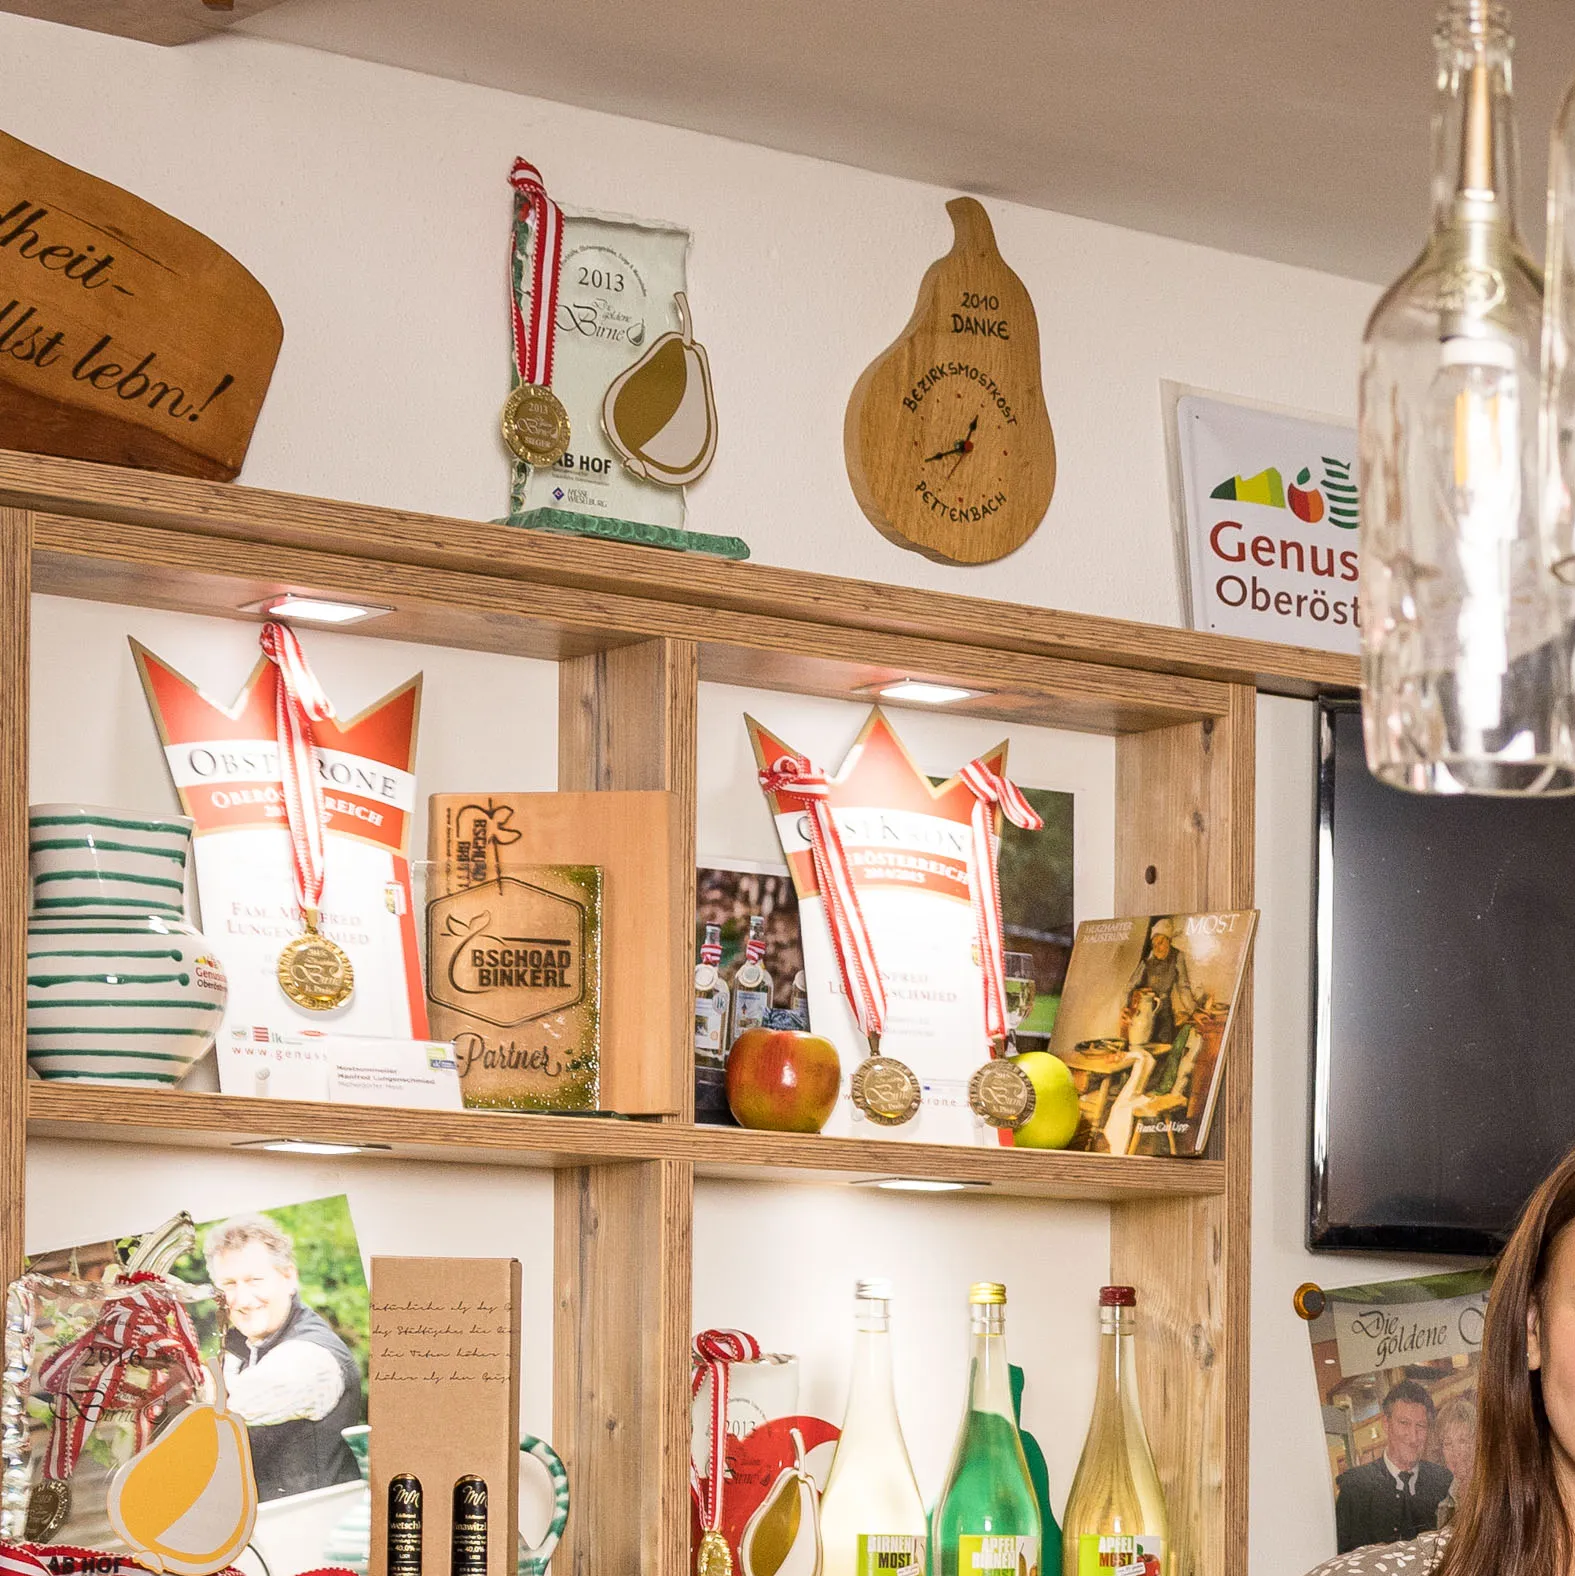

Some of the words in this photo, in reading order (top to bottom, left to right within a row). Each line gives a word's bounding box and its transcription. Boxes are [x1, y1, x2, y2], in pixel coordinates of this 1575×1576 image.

[578, 267, 625, 292] 2013
[961, 292, 999, 311] 2010
[951, 314, 1010, 340] DANKE
[72, 335, 234, 422] lebn!
[903, 361, 1018, 427] BEZIRKSMOSTKOST
[580, 455, 612, 475] HOF
[916, 480, 1007, 524] PETTENBACH
[1185, 913, 1241, 936] MOST
[478, 968, 572, 988] BINKERL
[453, 1031, 562, 1078] Partner
[1352, 1310, 1399, 1338] Die
[1376, 1323, 1448, 1367] goldene
[83, 1348, 142, 1368] 2016
[1098, 1537, 1133, 1553] APFEL
[878, 1552, 911, 1568] MOST
[1099, 1552, 1133, 1567] MOST
